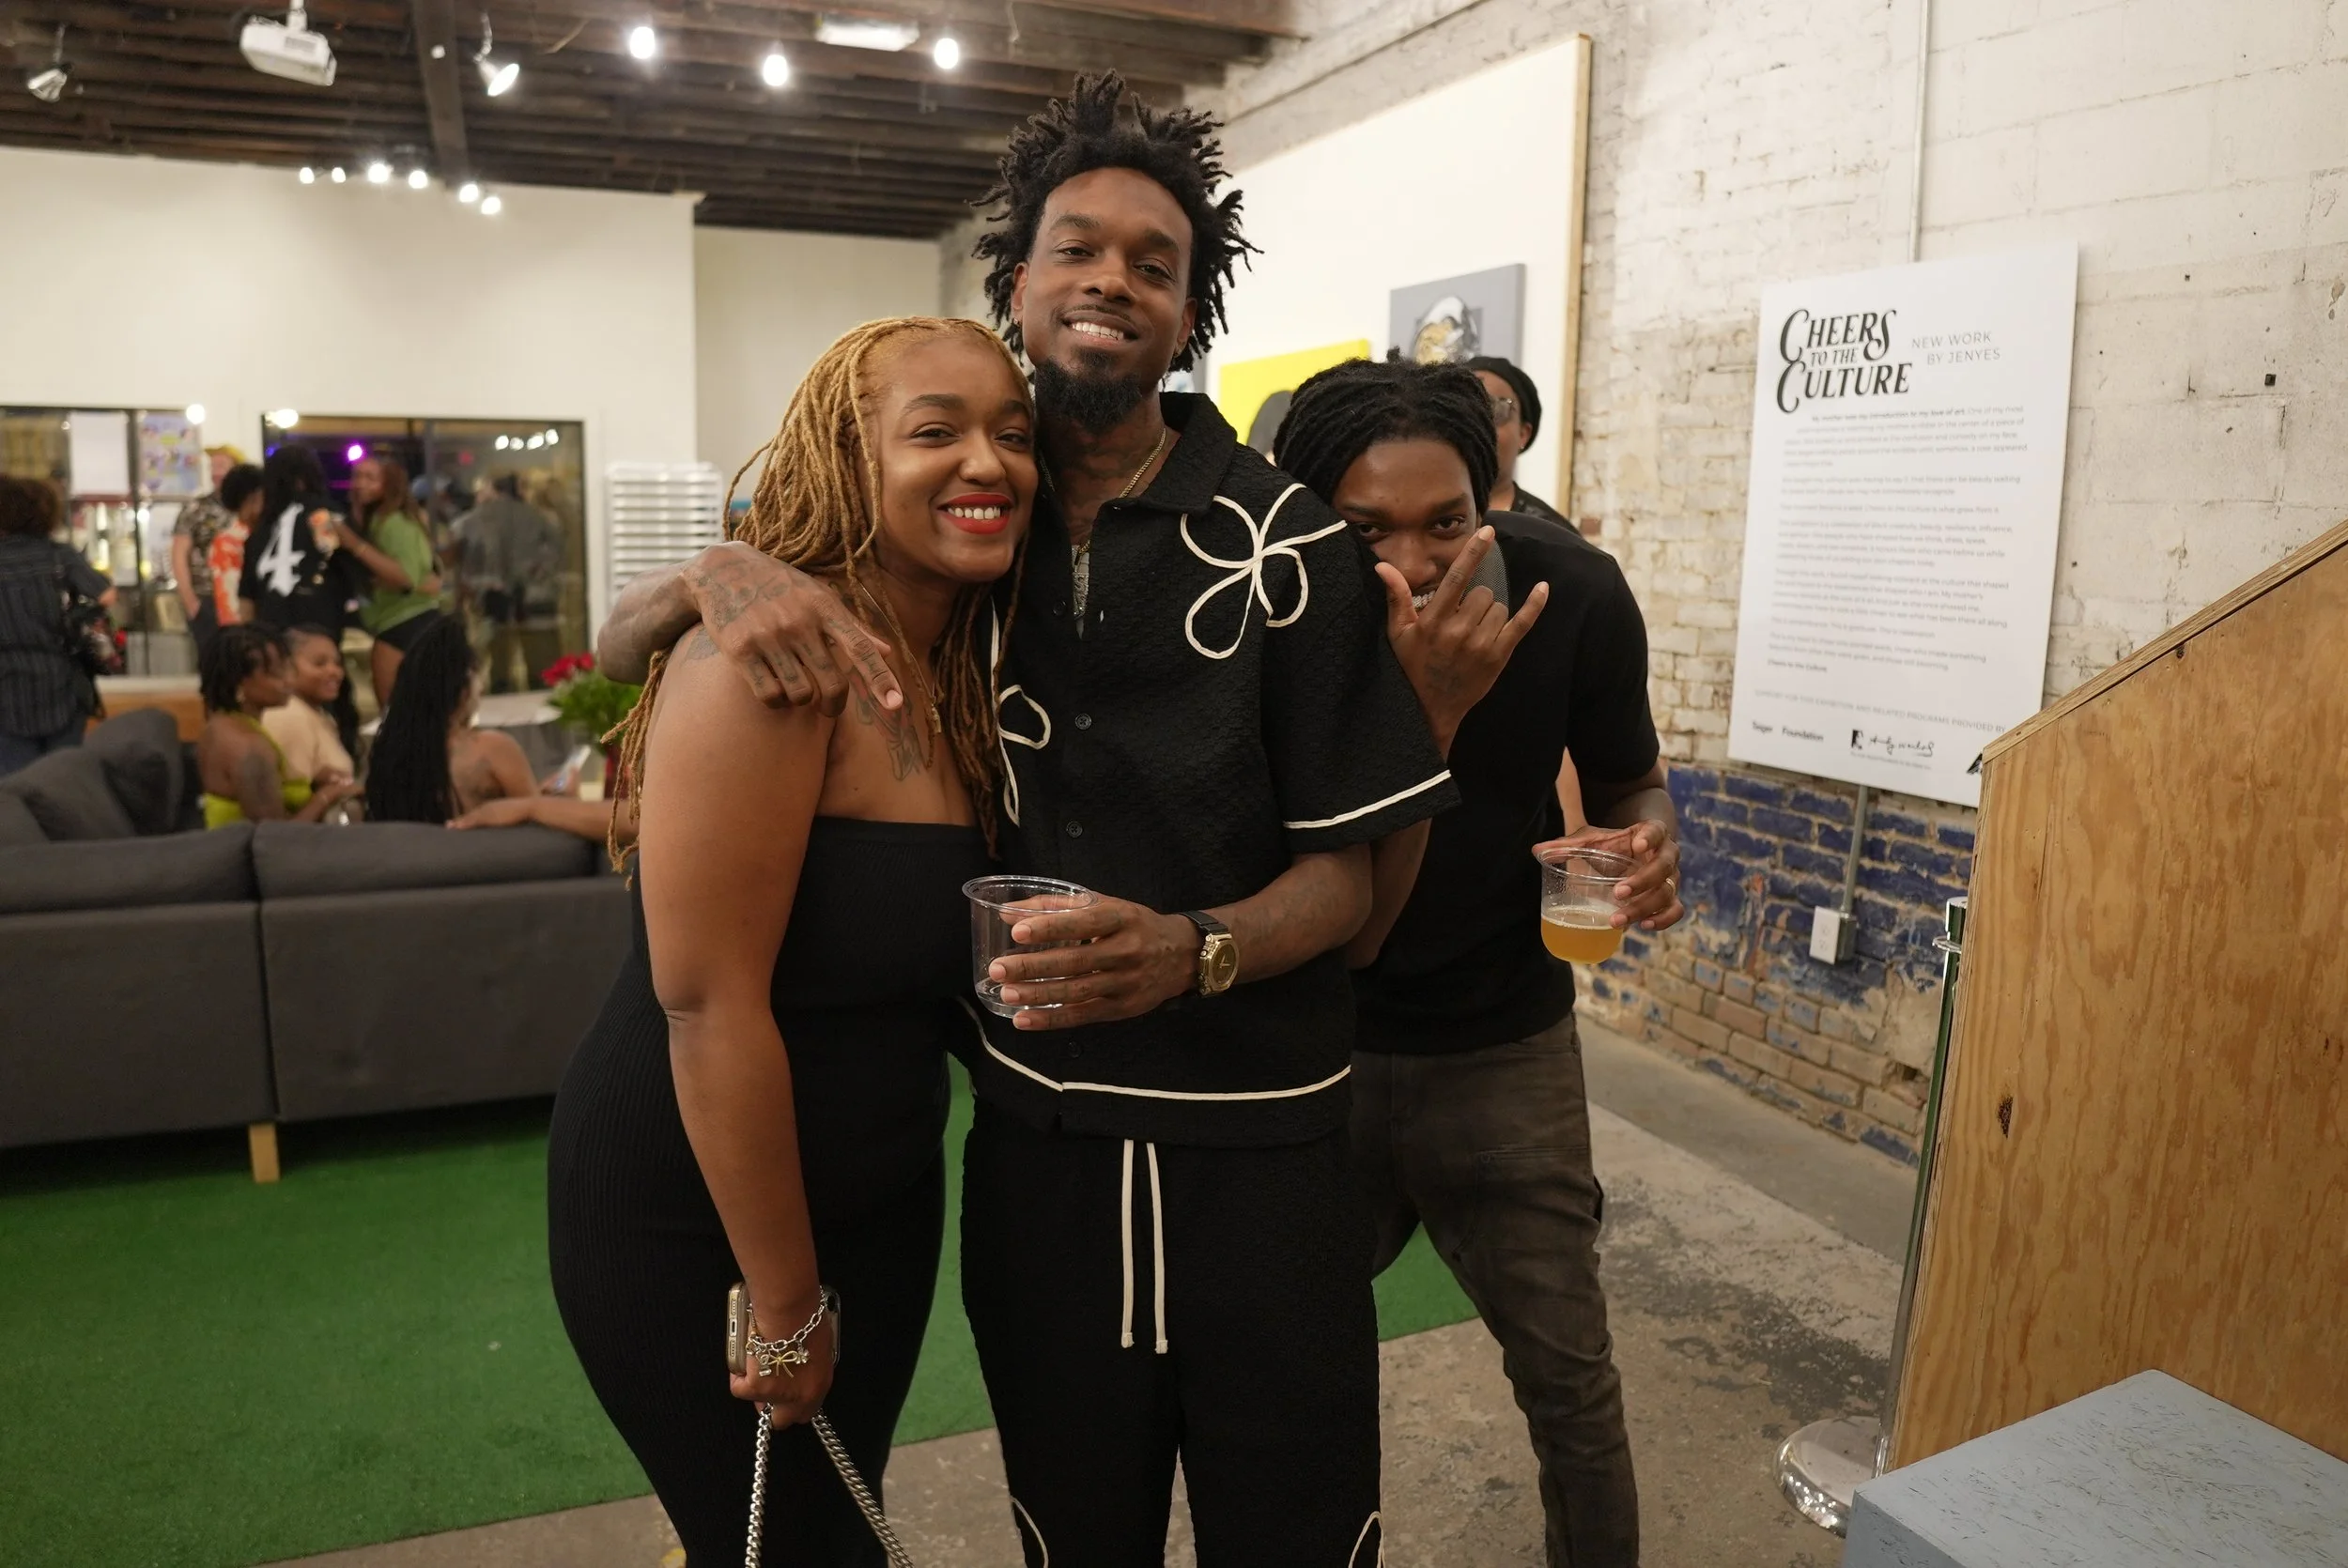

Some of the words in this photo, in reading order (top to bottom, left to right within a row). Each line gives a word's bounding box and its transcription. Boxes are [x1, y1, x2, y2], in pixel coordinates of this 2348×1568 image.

[1780, 309, 1896, 363] CHEERS
[1912, 335, 1943, 348] NEW
[1948, 331, 1991, 346] WORK
[1811, 350, 1828, 367] TO
[1832, 347, 1859, 365] THE
[1927, 353, 1943, 365] BY
[1948, 347, 2000, 363] JENYES
[1777, 361, 1912, 413] CULTURE
[256, 502, 306, 596] 4
[1907, 710, 1951, 725] PROGRAMS
[1952, 717, 1994, 732] PROVIDED
[1782, 725, 1824, 743] Foundation
